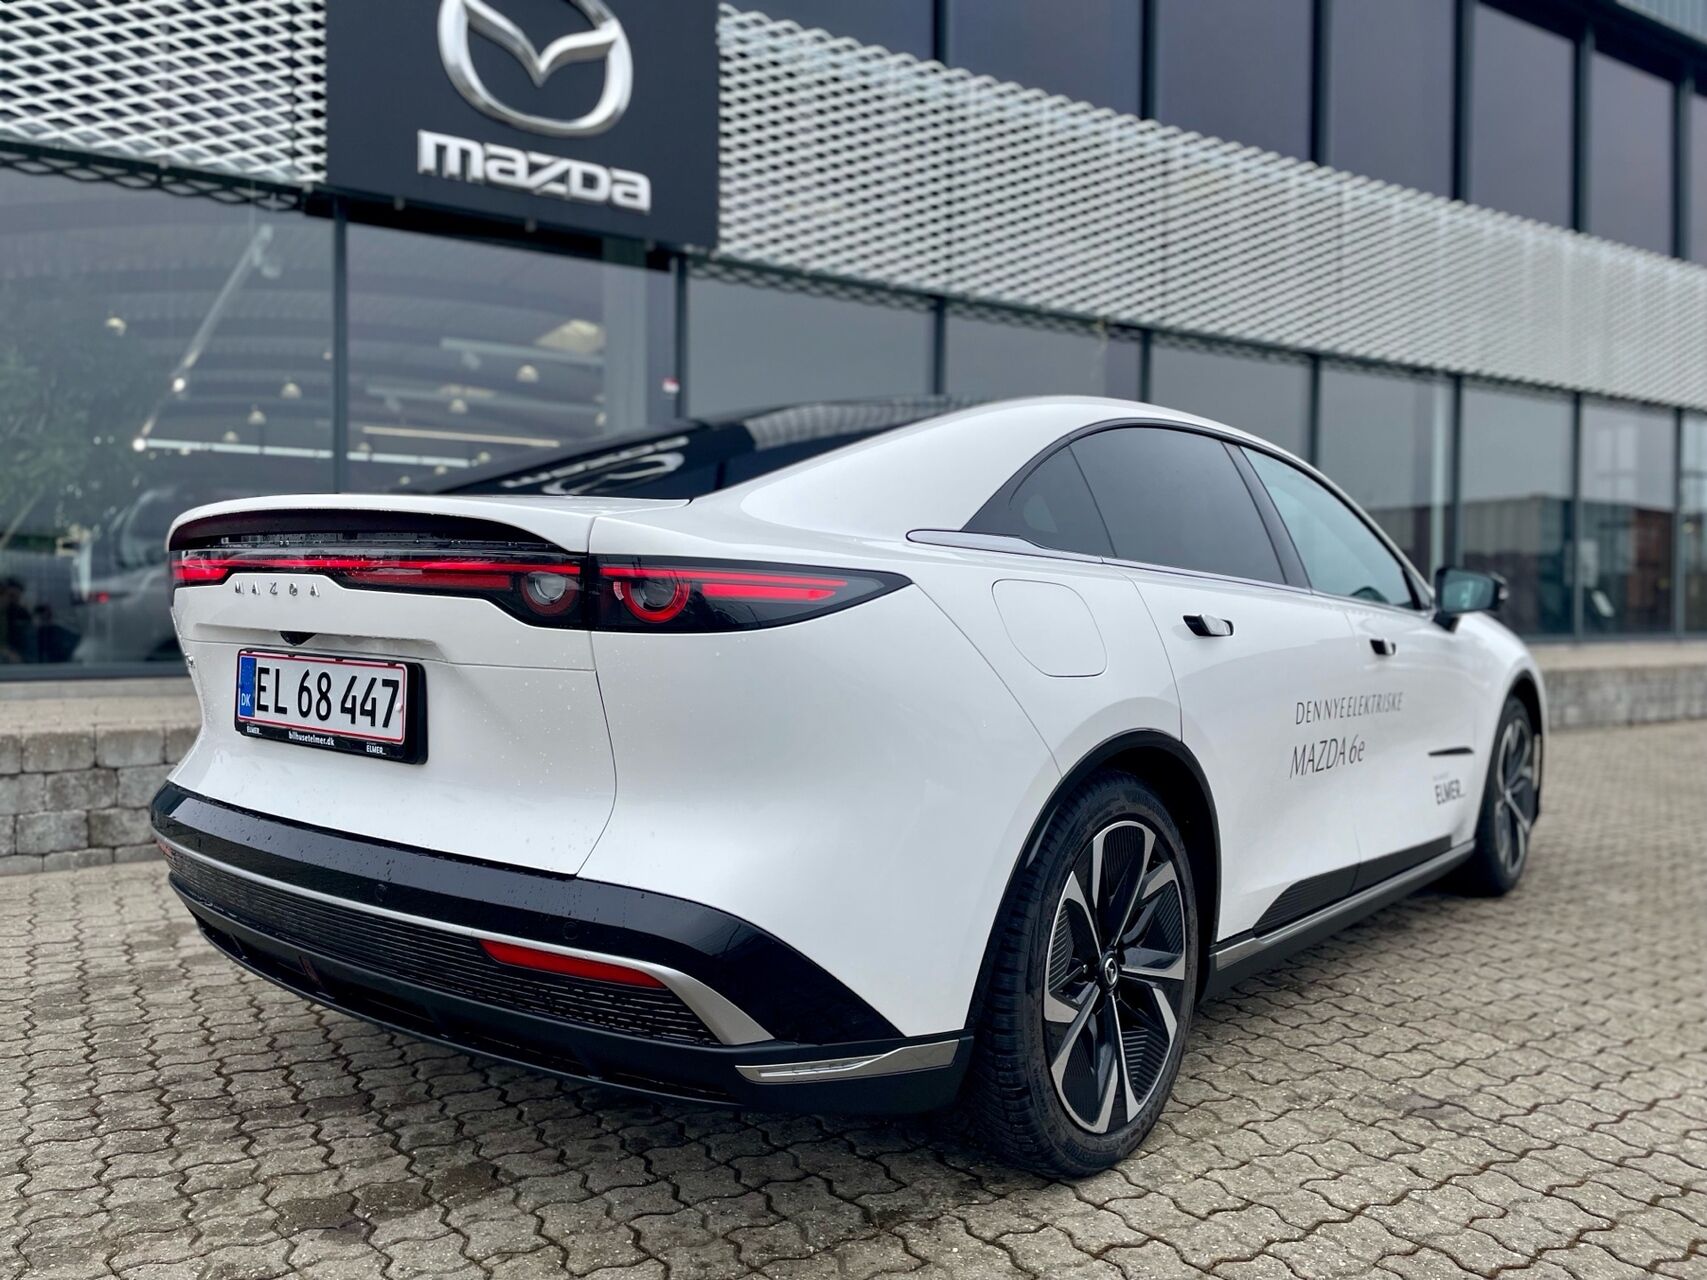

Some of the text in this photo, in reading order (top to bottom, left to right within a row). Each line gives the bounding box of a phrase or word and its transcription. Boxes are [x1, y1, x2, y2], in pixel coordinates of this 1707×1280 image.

[240, 692, 251, 707] DK
[256, 666, 400, 728] EL 68 447
[288, 730, 335, 747] bilhusetelmer.dk
[1289, 733, 1366, 780] MAZDA 6e
